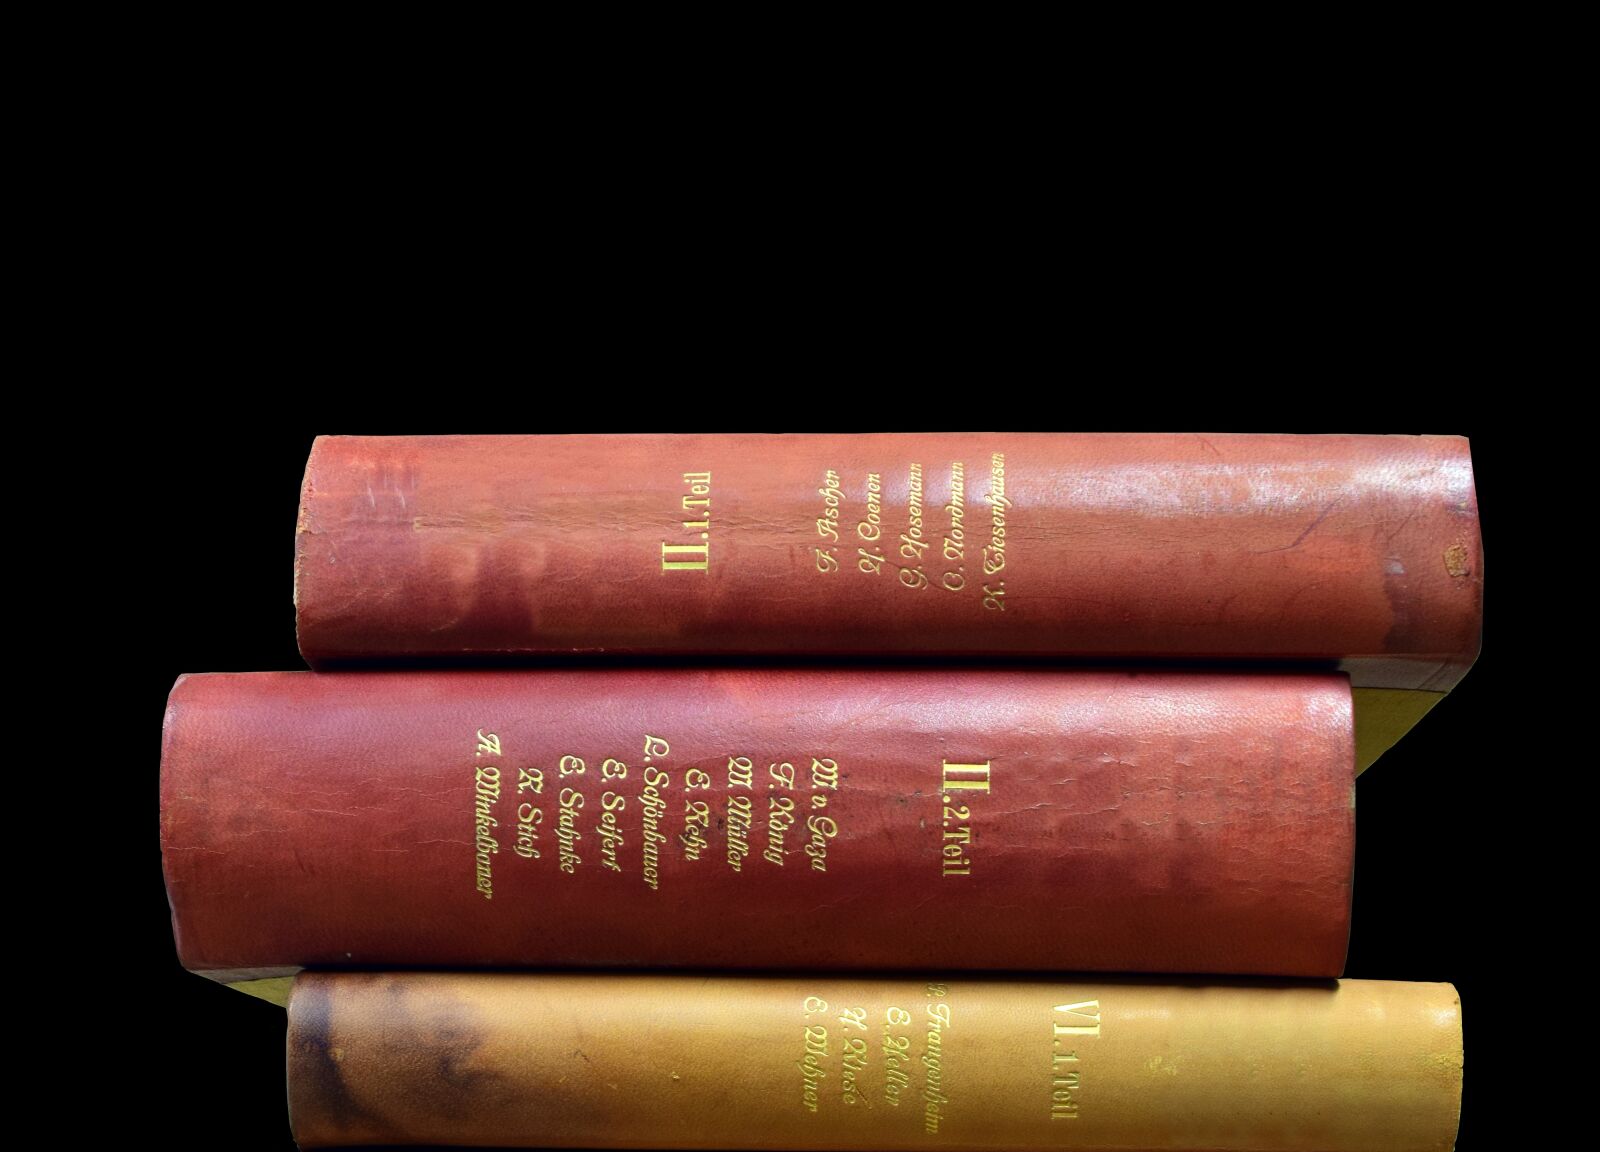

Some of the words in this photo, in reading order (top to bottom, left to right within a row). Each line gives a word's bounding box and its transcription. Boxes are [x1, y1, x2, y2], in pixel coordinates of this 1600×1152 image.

[816, 470, 846, 542] Ascher
[857, 473, 880, 540] Coenen
[900, 463, 928, 559] Hosemann
[944, 462, 964, 560] Nordmann
[983, 453, 1012, 574] Tiesenhausen
[816, 547, 838, 572] F.
[899, 565, 928, 590] G.
[476, 729, 501, 756] A.
[559, 755, 585, 778] E.
[644, 735, 669, 762] L.
[601, 759, 627, 783] E.
[684, 768, 710, 792] E.
[769, 762, 794, 790] F.
[638, 767, 669, 890] Schönbauer
[811, 795, 828, 809] v.
[513, 803, 542, 858] Stich
[554, 788, 584, 874] Stahnke
[596, 792, 625, 872] Seifert
[727, 796, 752, 872] Müller
[763, 798, 794, 866] König
[805, 816, 838, 871] Gaza
[804, 997, 828, 1018] E.
[886, 1007, 911, 1028] E.
[922, 1003, 950, 1134] Frangenheim
